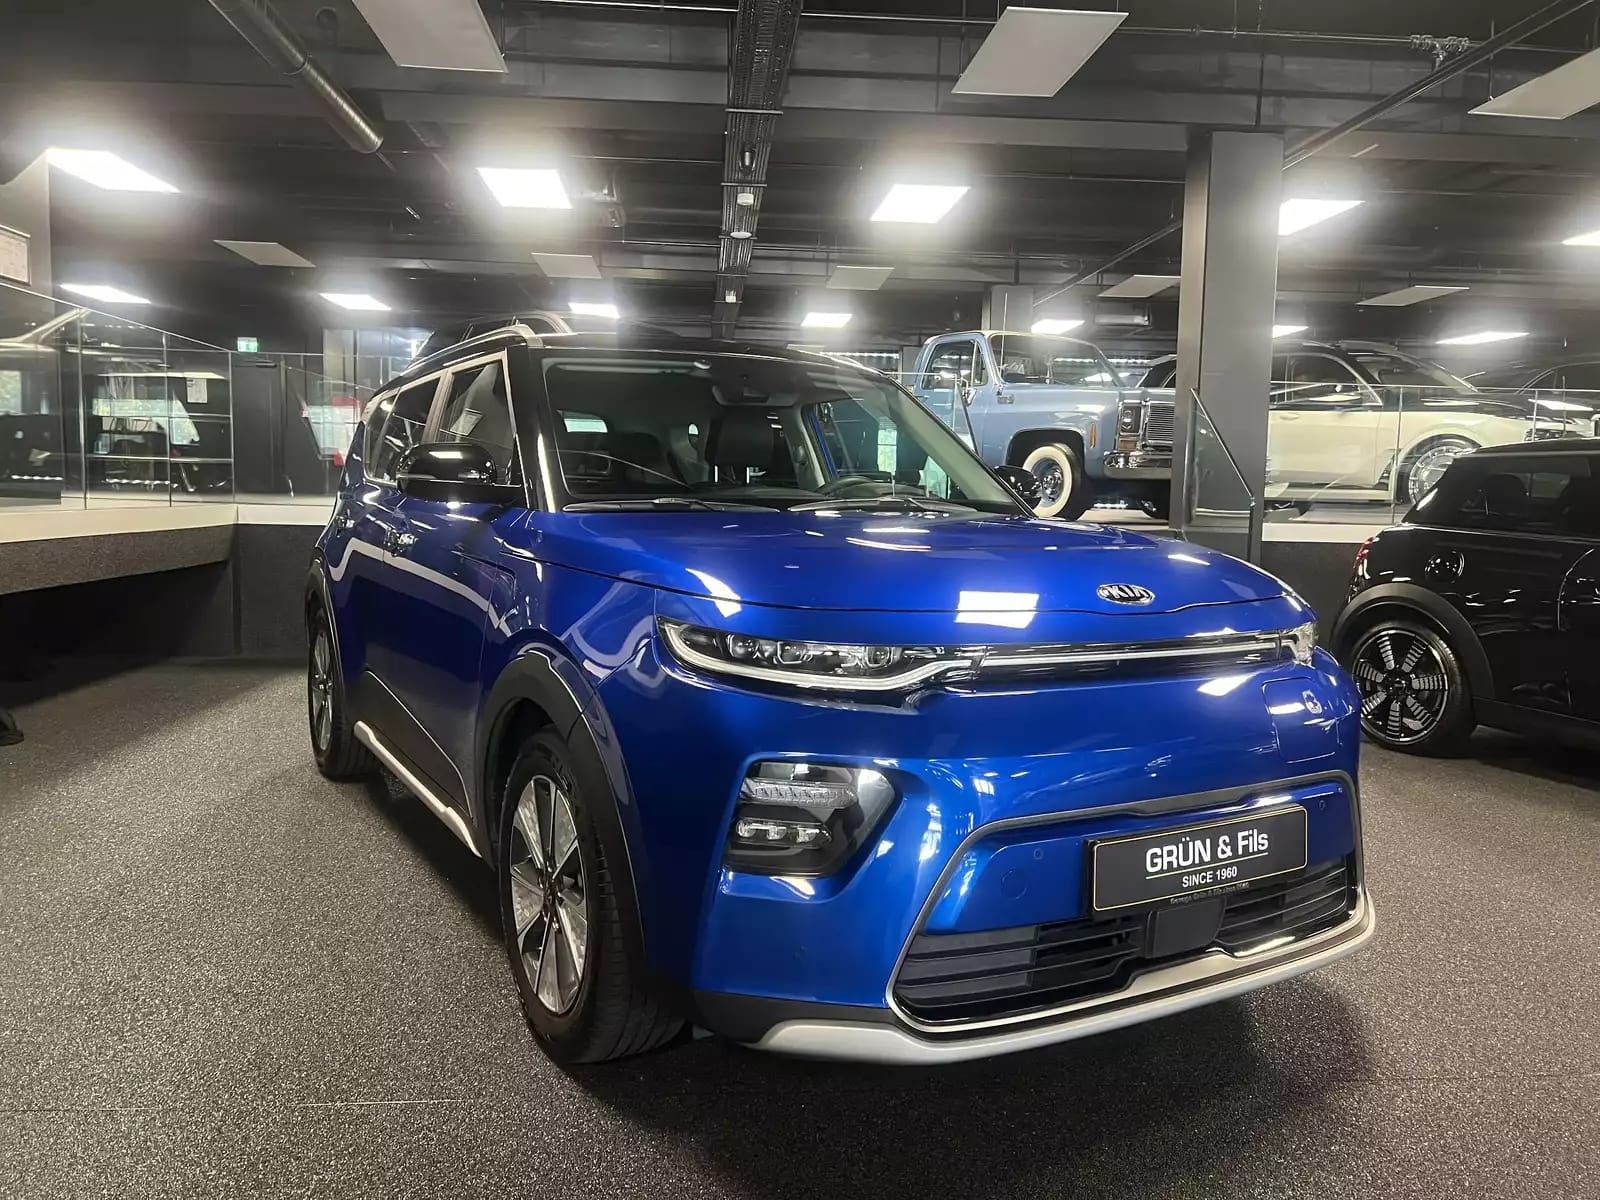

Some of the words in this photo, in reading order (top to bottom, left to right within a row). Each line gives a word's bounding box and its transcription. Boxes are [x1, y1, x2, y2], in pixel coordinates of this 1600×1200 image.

[1104, 585, 1150, 600] KIA
[1145, 836, 1211, 873] GRÜN
[1217, 835, 1232, 859] &
[1238, 829, 1269, 855] Fils
[1182, 871, 1213, 888] SINCE
[1216, 866, 1238, 881] 1960
